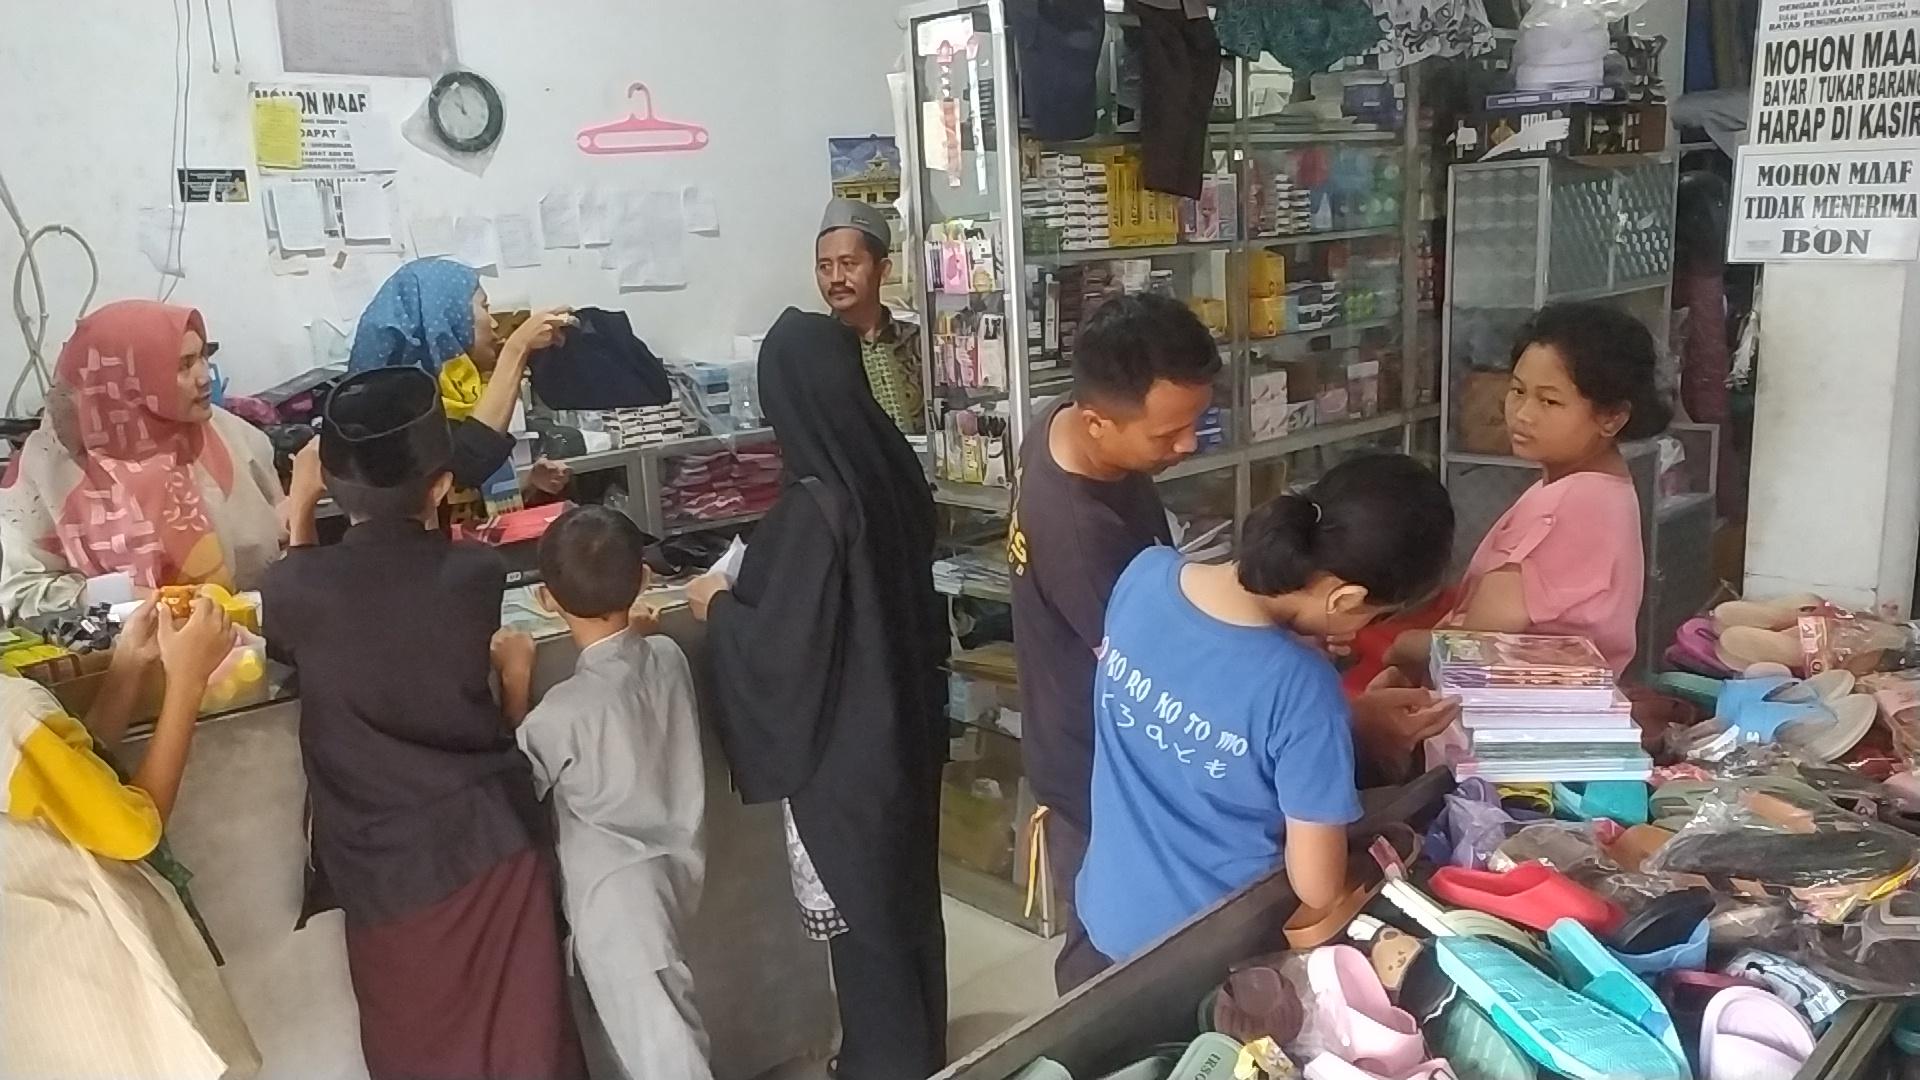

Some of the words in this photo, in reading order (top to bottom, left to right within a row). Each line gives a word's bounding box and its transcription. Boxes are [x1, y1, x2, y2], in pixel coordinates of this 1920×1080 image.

[1763, 33, 1855, 77] MOHON
[1862, 28, 1920, 68] MAA
[322, 91, 367, 115] MAAF
[1763, 77, 1808, 107] BAYAR
[1819, 73, 1864, 103] TUKAR
[1757, 107, 1825, 145] HARAP
[1831, 105, 1853, 141] DI
[1858, 101, 1920, 140] KASIR
[1757, 163, 1841, 187] MOHON
[1849, 160, 1913, 185] MAAF
[1744, 195, 1806, 219] TIDAK
[1812, 193, 1918, 219] MENERIMA
[1780, 229, 1872, 255] BON
